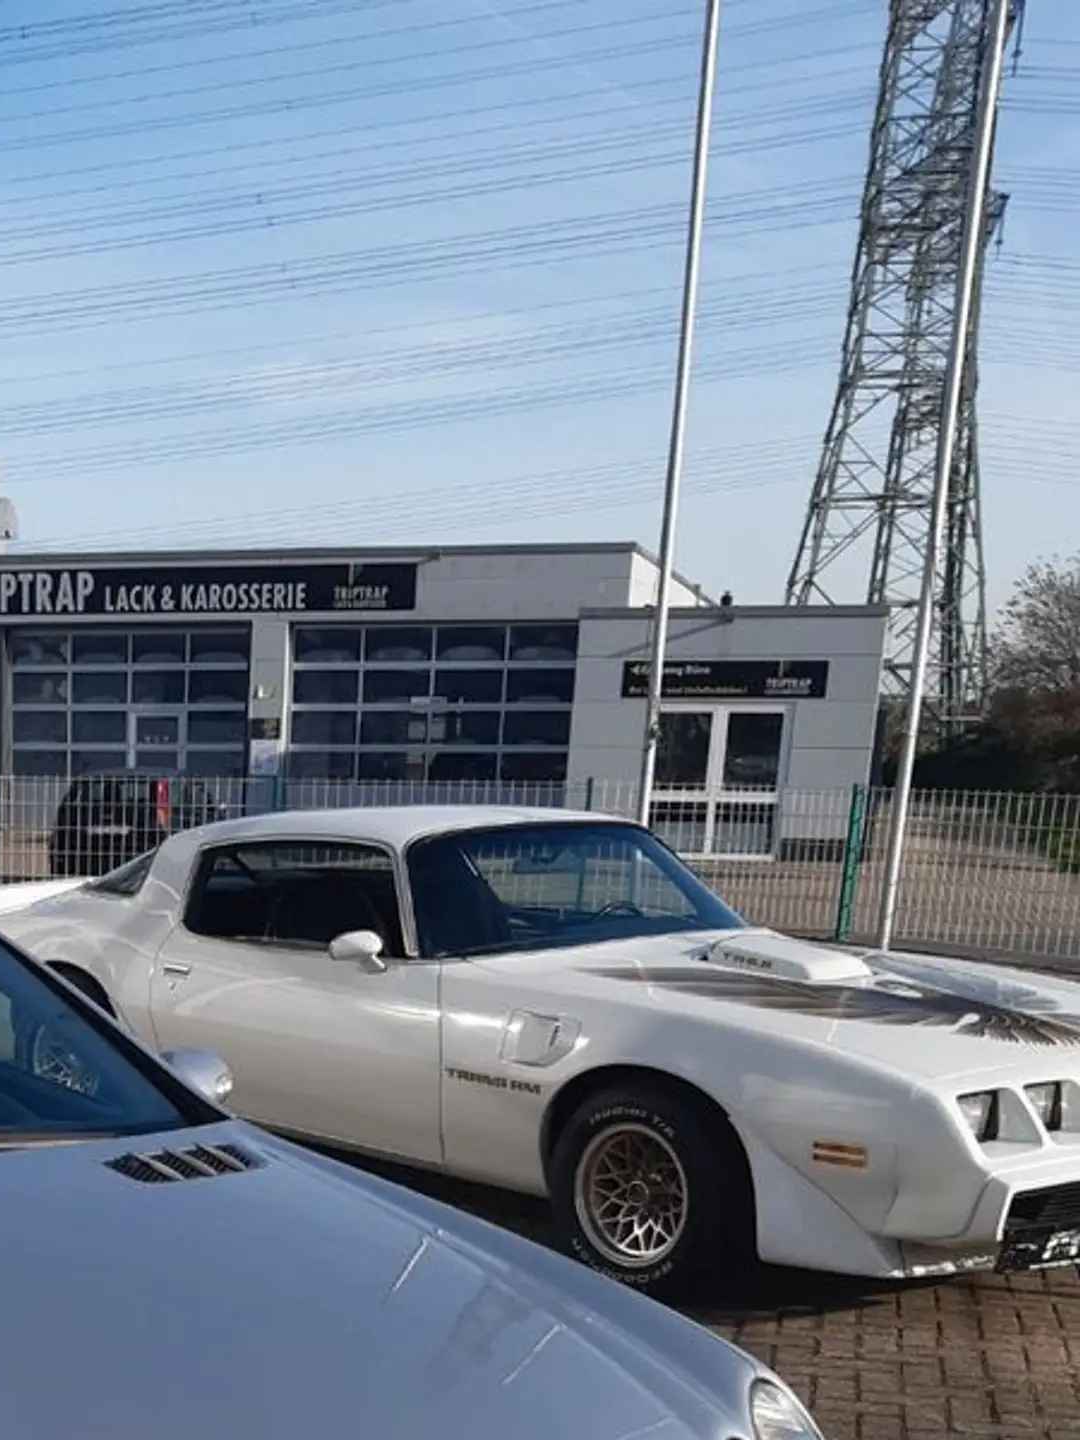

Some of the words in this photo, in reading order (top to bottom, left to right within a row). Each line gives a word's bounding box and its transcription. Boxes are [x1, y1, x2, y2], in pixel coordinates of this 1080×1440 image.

[104, 584, 156, 612] LACK
[160, 585, 176, 611] &
[181, 582, 307, 611] KAROSSERIE
[333, 584, 390, 600] TRIPTRAP
